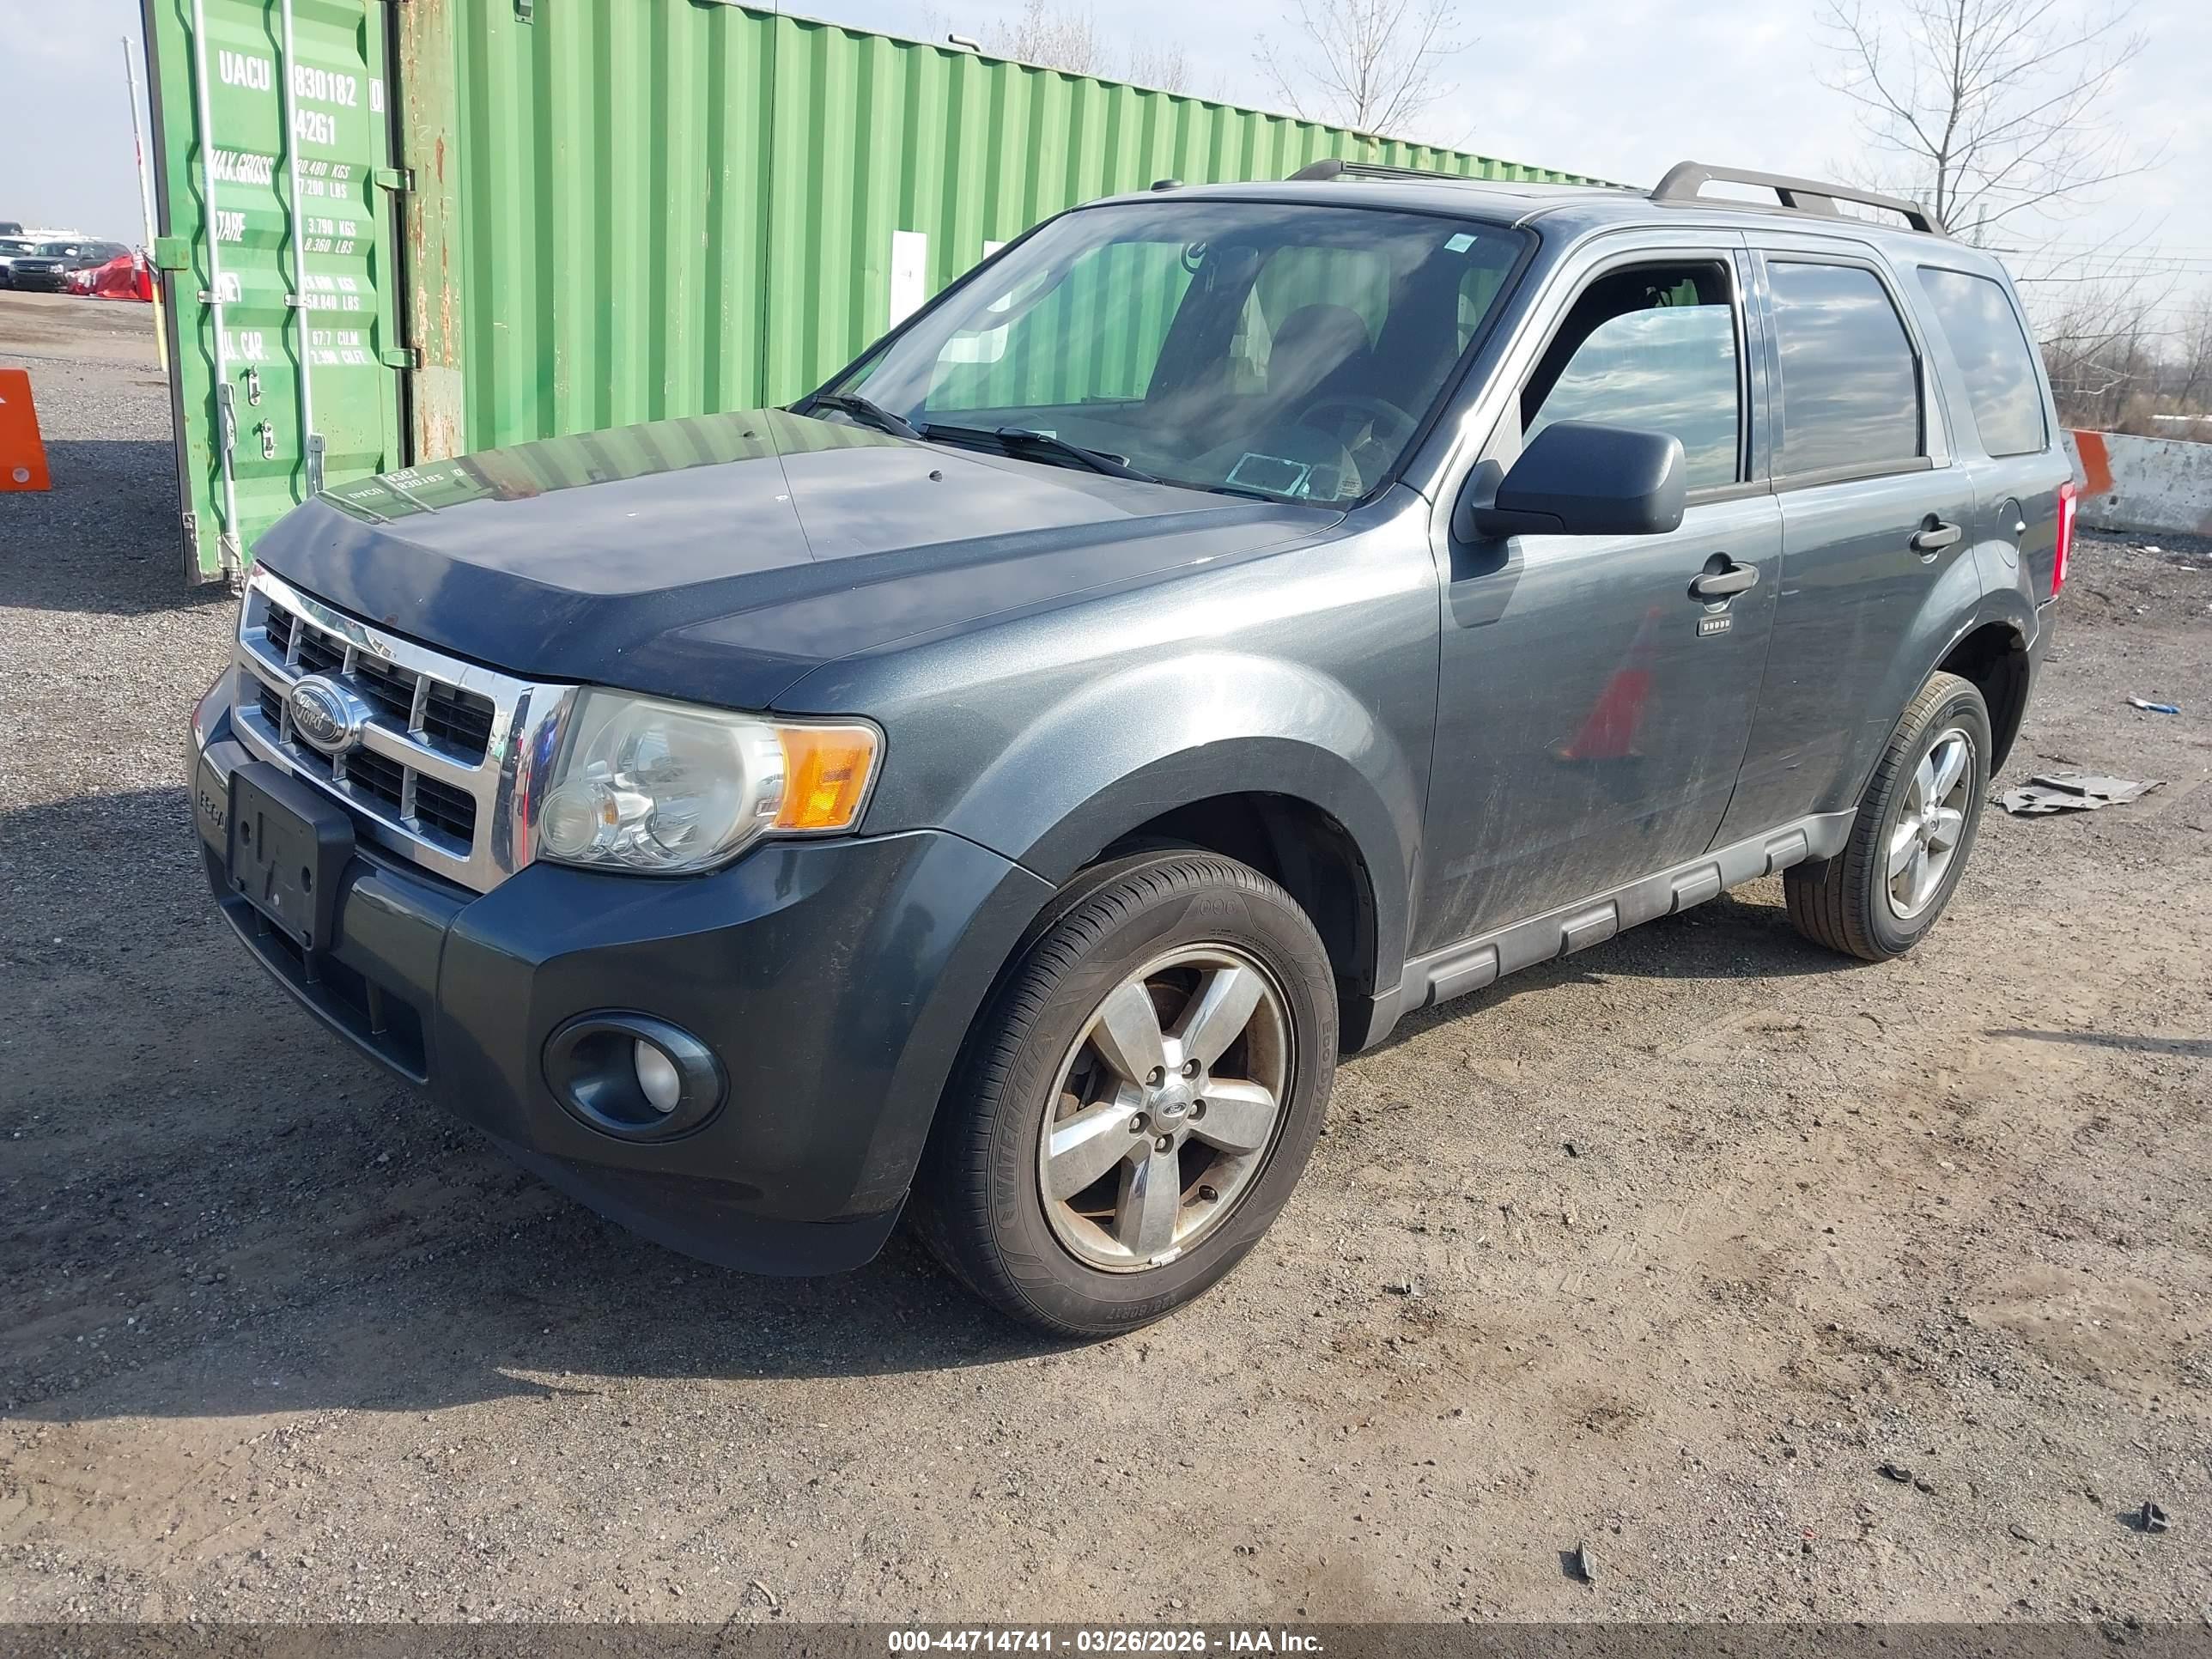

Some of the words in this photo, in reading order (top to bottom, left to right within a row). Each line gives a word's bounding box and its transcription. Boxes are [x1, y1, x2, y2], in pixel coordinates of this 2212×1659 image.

[219, 50, 270, 91] UACU
[295, 64, 357, 106] 830182
[331, 163, 350, 179] KGS
[330, 181, 347, 198] LBS
[216, 210, 246, 242] TARE
[307, 217, 333, 234] 3.790
[338, 219, 356, 237] KGS
[304, 237, 331, 252] 8.360
[335, 240, 354, 254] LBS
[342, 295, 359, 310] LBS
[312, 331, 331, 346] 67.7
[294, 692, 324, 732] Ford
